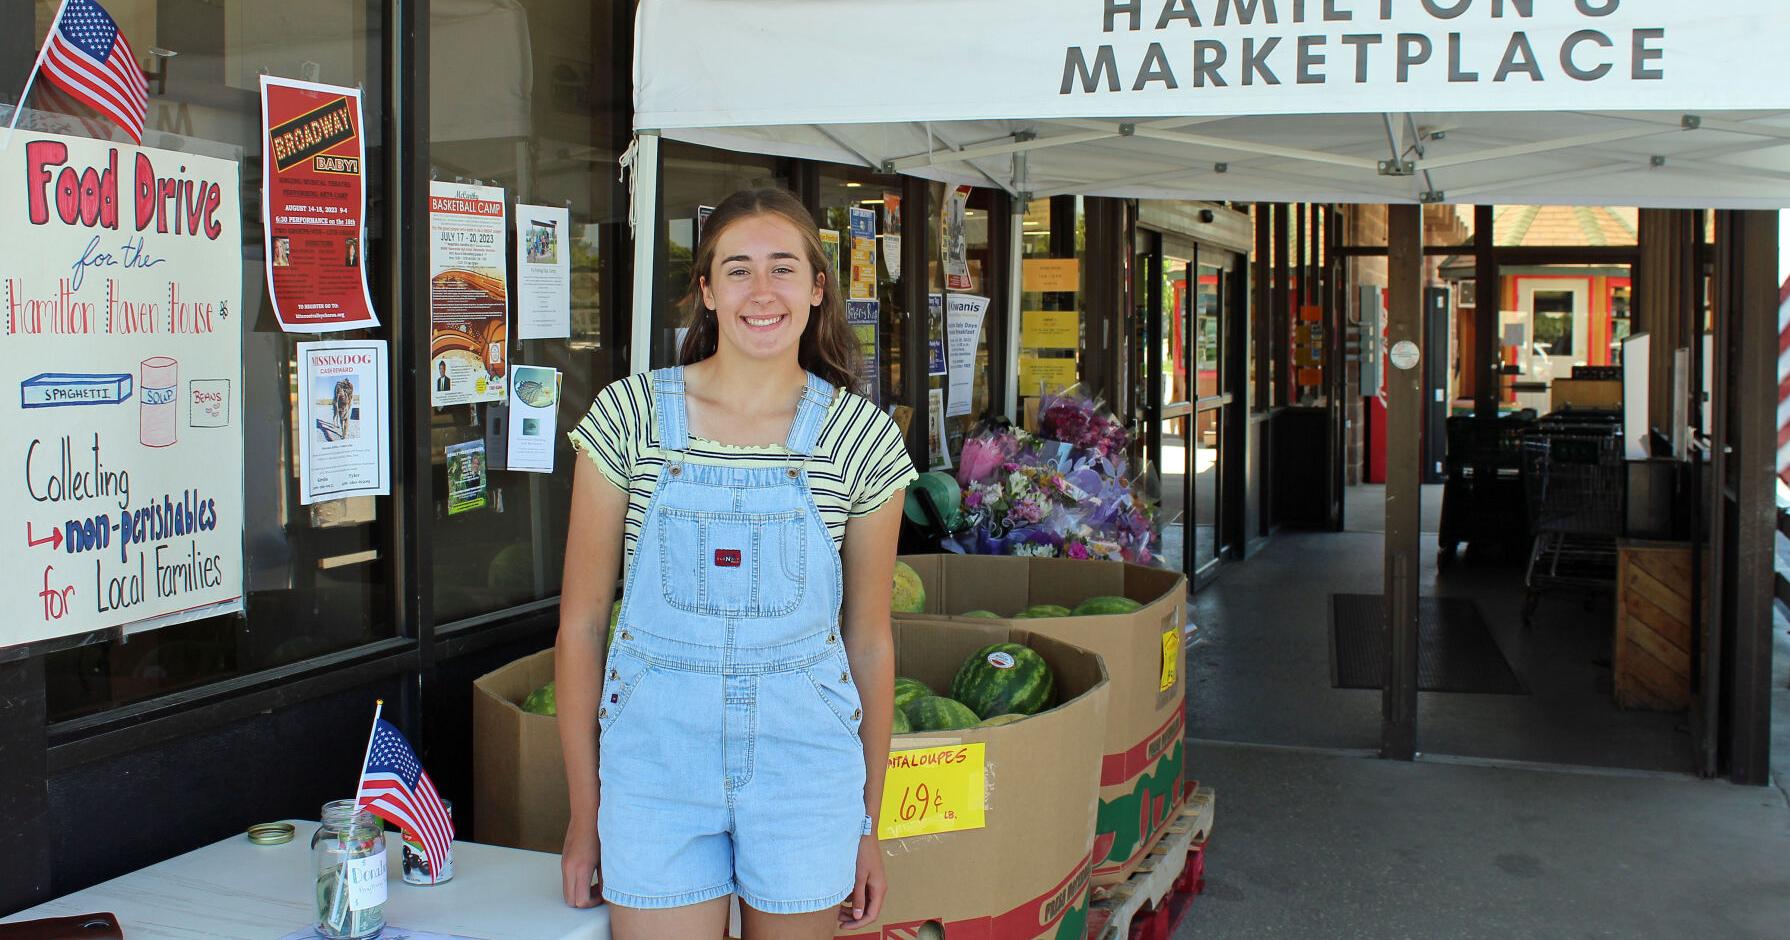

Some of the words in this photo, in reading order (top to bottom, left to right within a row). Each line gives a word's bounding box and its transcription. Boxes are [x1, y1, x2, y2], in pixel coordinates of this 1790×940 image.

[1059, 27, 1665, 95] MARKETPLACE
[274, 106, 349, 160] BROADWAY
[316, 156, 358, 173] BABY!
[26, 139, 119, 231] Food
[134, 151, 222, 240] Drive
[284, 204, 307, 213] AUGUST
[432, 198, 477, 213] BASKETBALL
[477, 202, 501, 214] CAMP
[288, 216, 329, 225] PERFORMANCE
[440, 231, 455, 242] JULY
[456, 232, 464, 242] 17
[479, 233, 495, 243] 2023
[72, 235, 118, 291] for
[121, 235, 165, 268] the
[9, 278, 96, 335] Hamilton
[108, 278, 160, 334] Haven
[170, 281, 214, 334] House
[312, 355, 343, 366] MISSING
[343, 354, 371, 365] DOG
[45, 387, 111, 401] SPAGHETTI
[147, 389, 173, 404] SOUP
[193, 390, 223, 404] BEANS
[26, 432, 130, 510] Collecting
[65, 488, 217, 564] non-perishables
[39, 565, 76, 621] for
[97, 552, 145, 613] Local
[156, 540, 222, 598] Families
